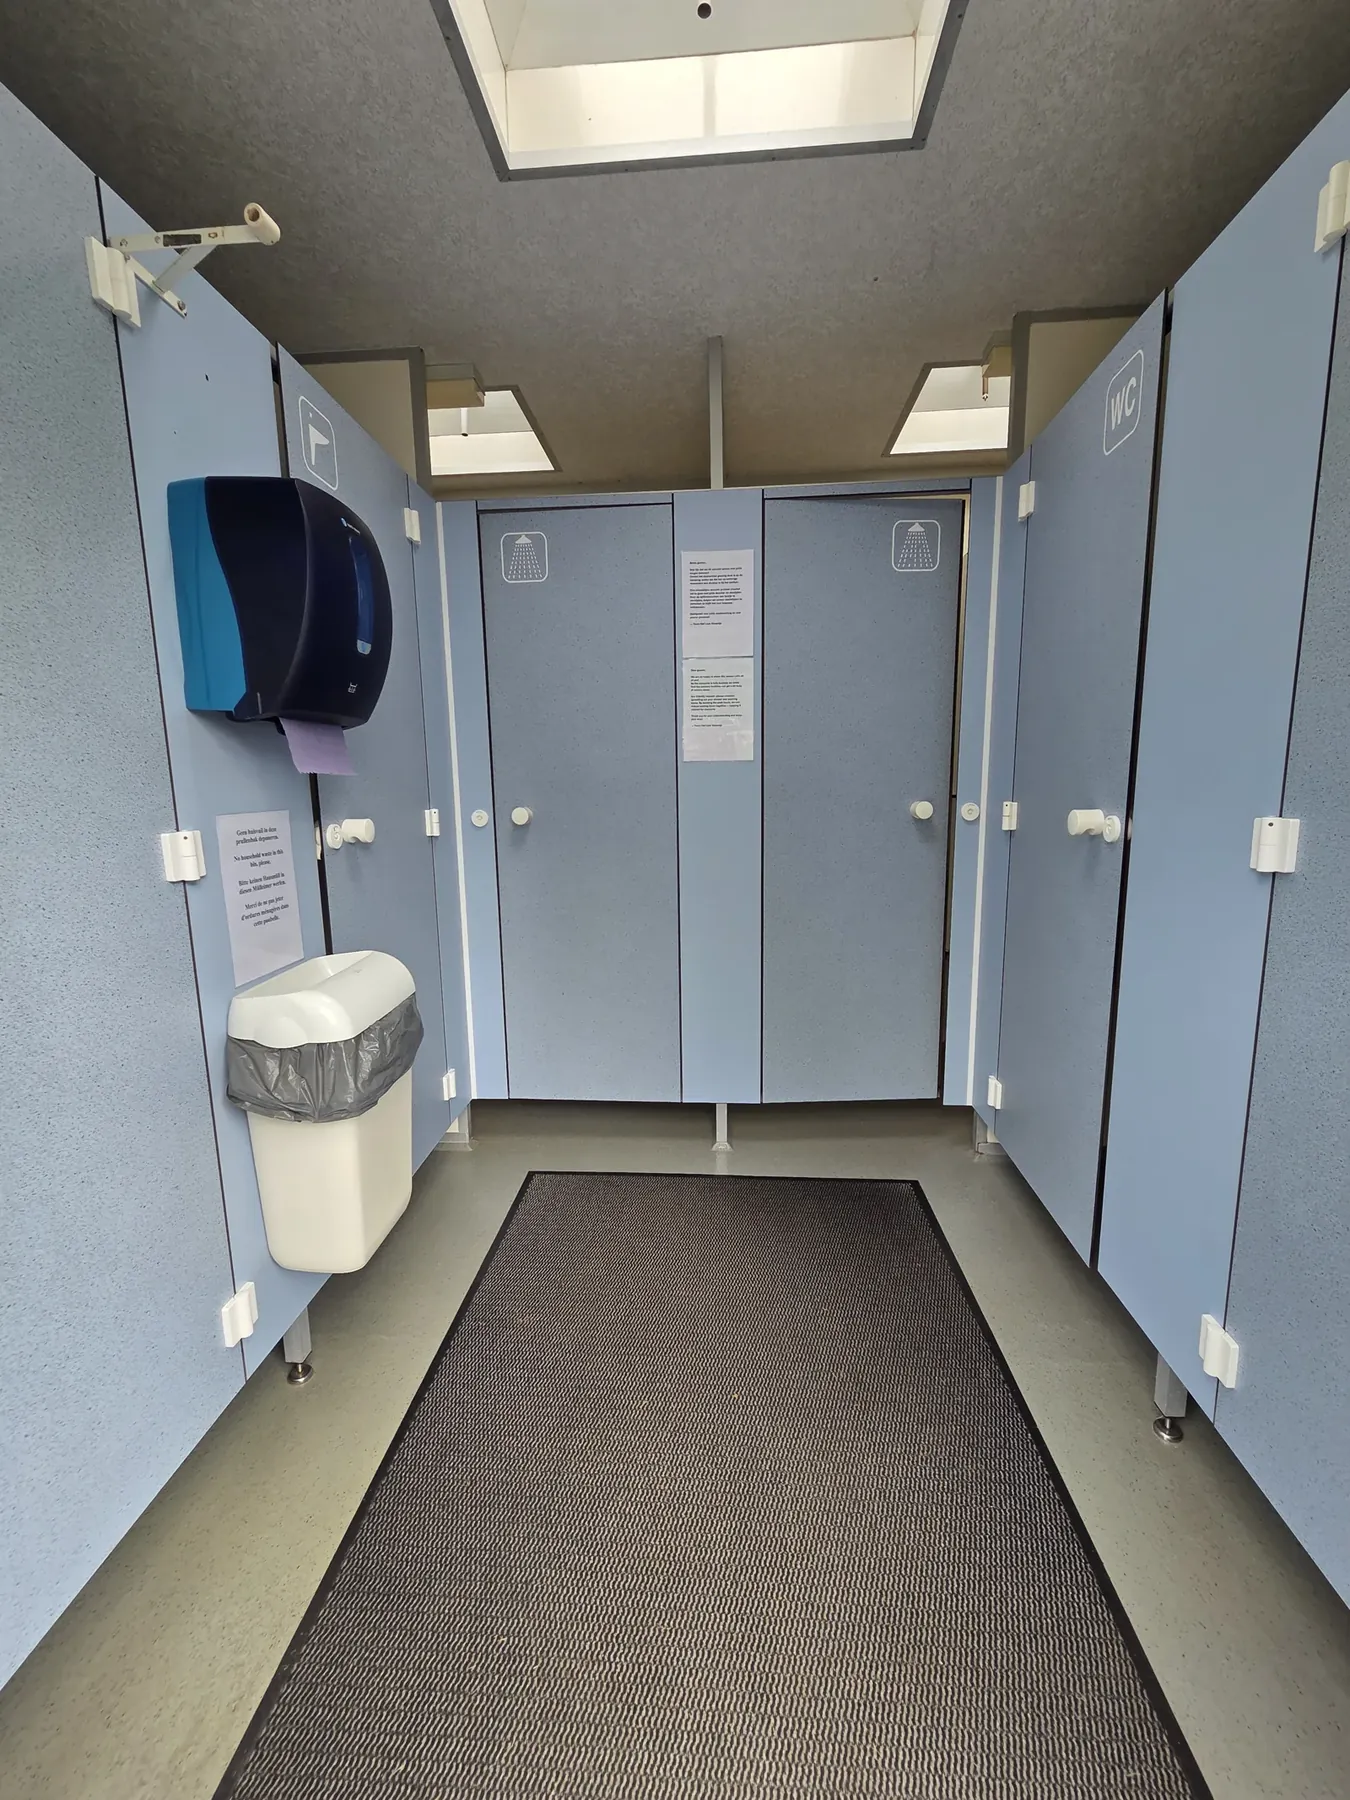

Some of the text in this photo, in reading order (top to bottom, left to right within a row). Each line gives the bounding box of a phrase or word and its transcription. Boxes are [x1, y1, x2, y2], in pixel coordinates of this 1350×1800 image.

[1111, 376, 1137, 431] WC
[236, 837, 258, 846] prullenbak
[240, 852, 261, 860] household
[249, 877, 263, 885] keinen
[239, 887, 252, 895] diesen
[244, 901, 257, 910] Merci
[274, 895, 284, 904] jeter
